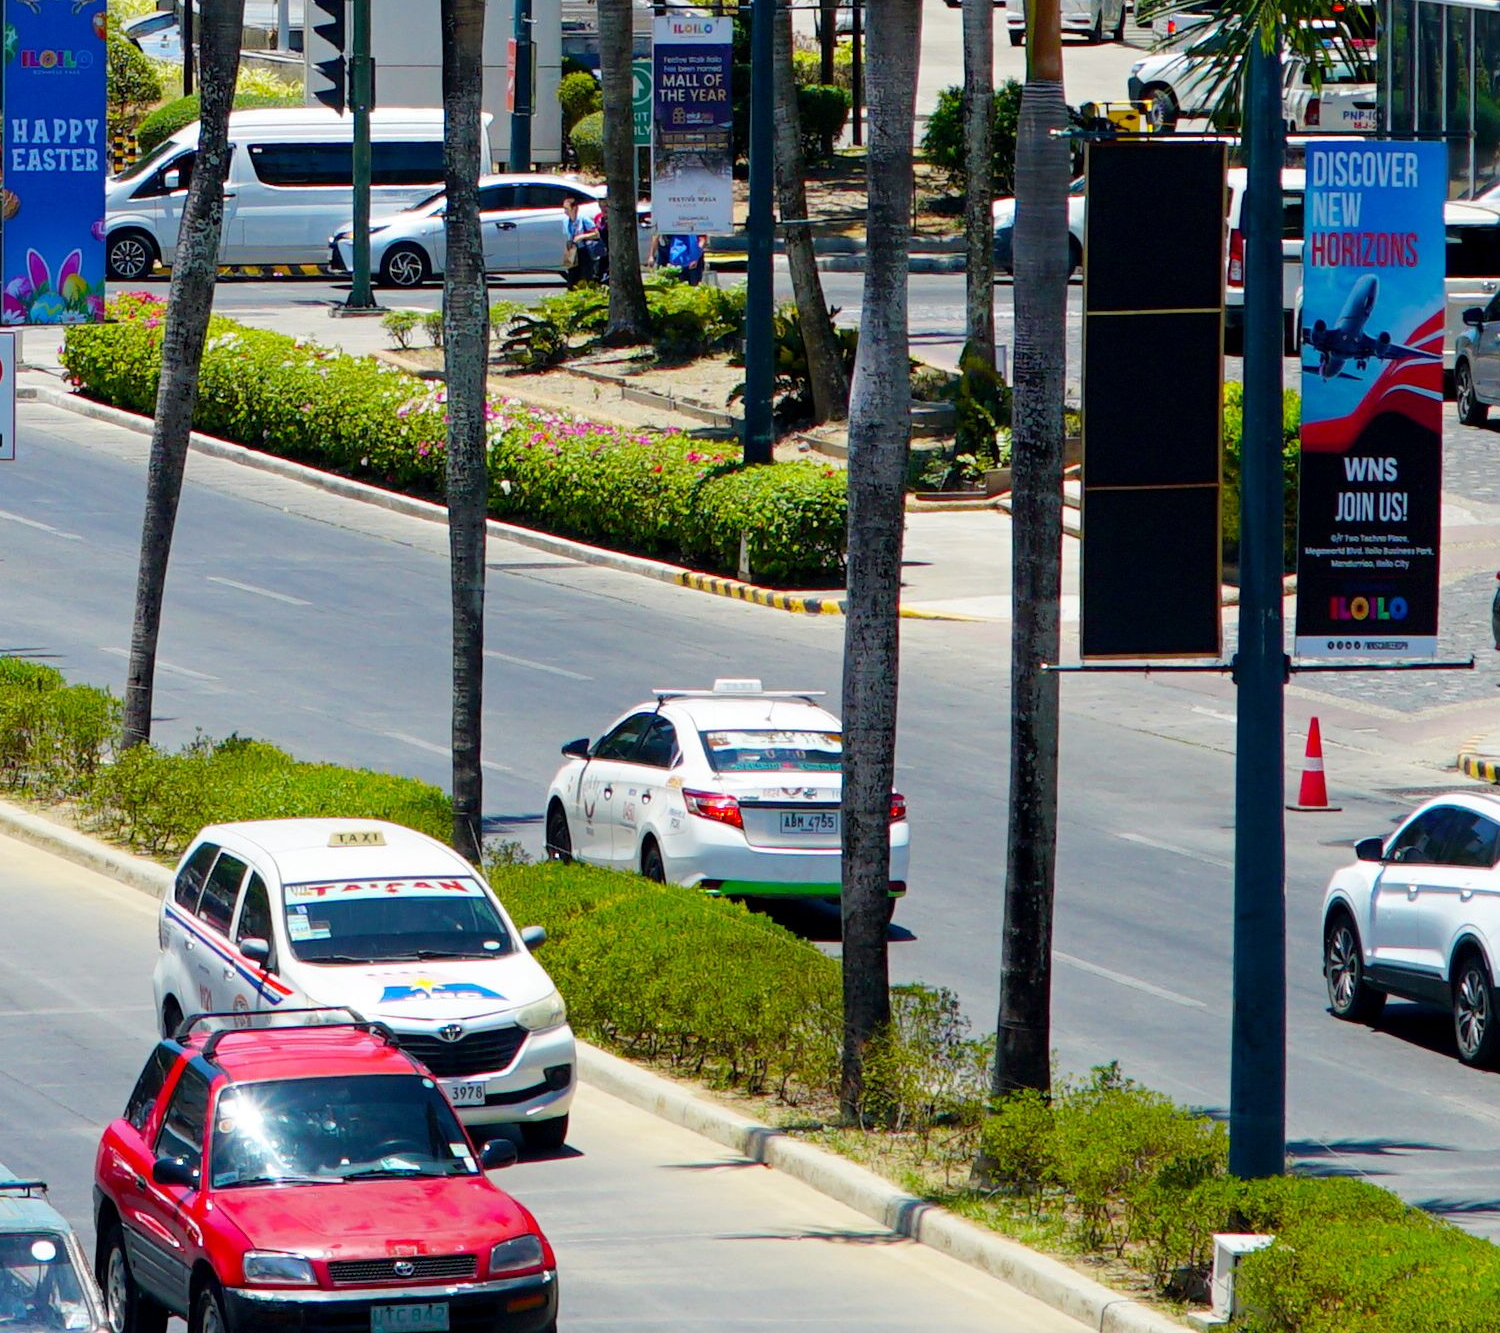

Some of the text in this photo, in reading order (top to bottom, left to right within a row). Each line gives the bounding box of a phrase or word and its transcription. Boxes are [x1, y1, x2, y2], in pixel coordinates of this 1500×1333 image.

[673, 23, 713, 34] ILOILO
[21, 50, 94, 69] ILOILO
[662, 73, 723, 87] MALL OF
[659, 88, 727, 102] THE YEAR
[12, 118, 99, 144] HAPPY
[12, 148, 99, 172] EASTER
[1313, 151, 1418, 188] DISCOVER
[1312, 192, 1362, 227] NEW
[1311, 231, 1419, 268] HORIZONS
[1344, 457, 1398, 482] WNS
[1335, 492, 1408, 522] JOIN US!
[1394, 559, 1410, 570] City
[1329, 596, 1409, 621] ILOILO
[808, 815, 834, 830] 4755
[336, 832, 380, 844] TAXI
[452, 1085, 484, 1101] 3978
